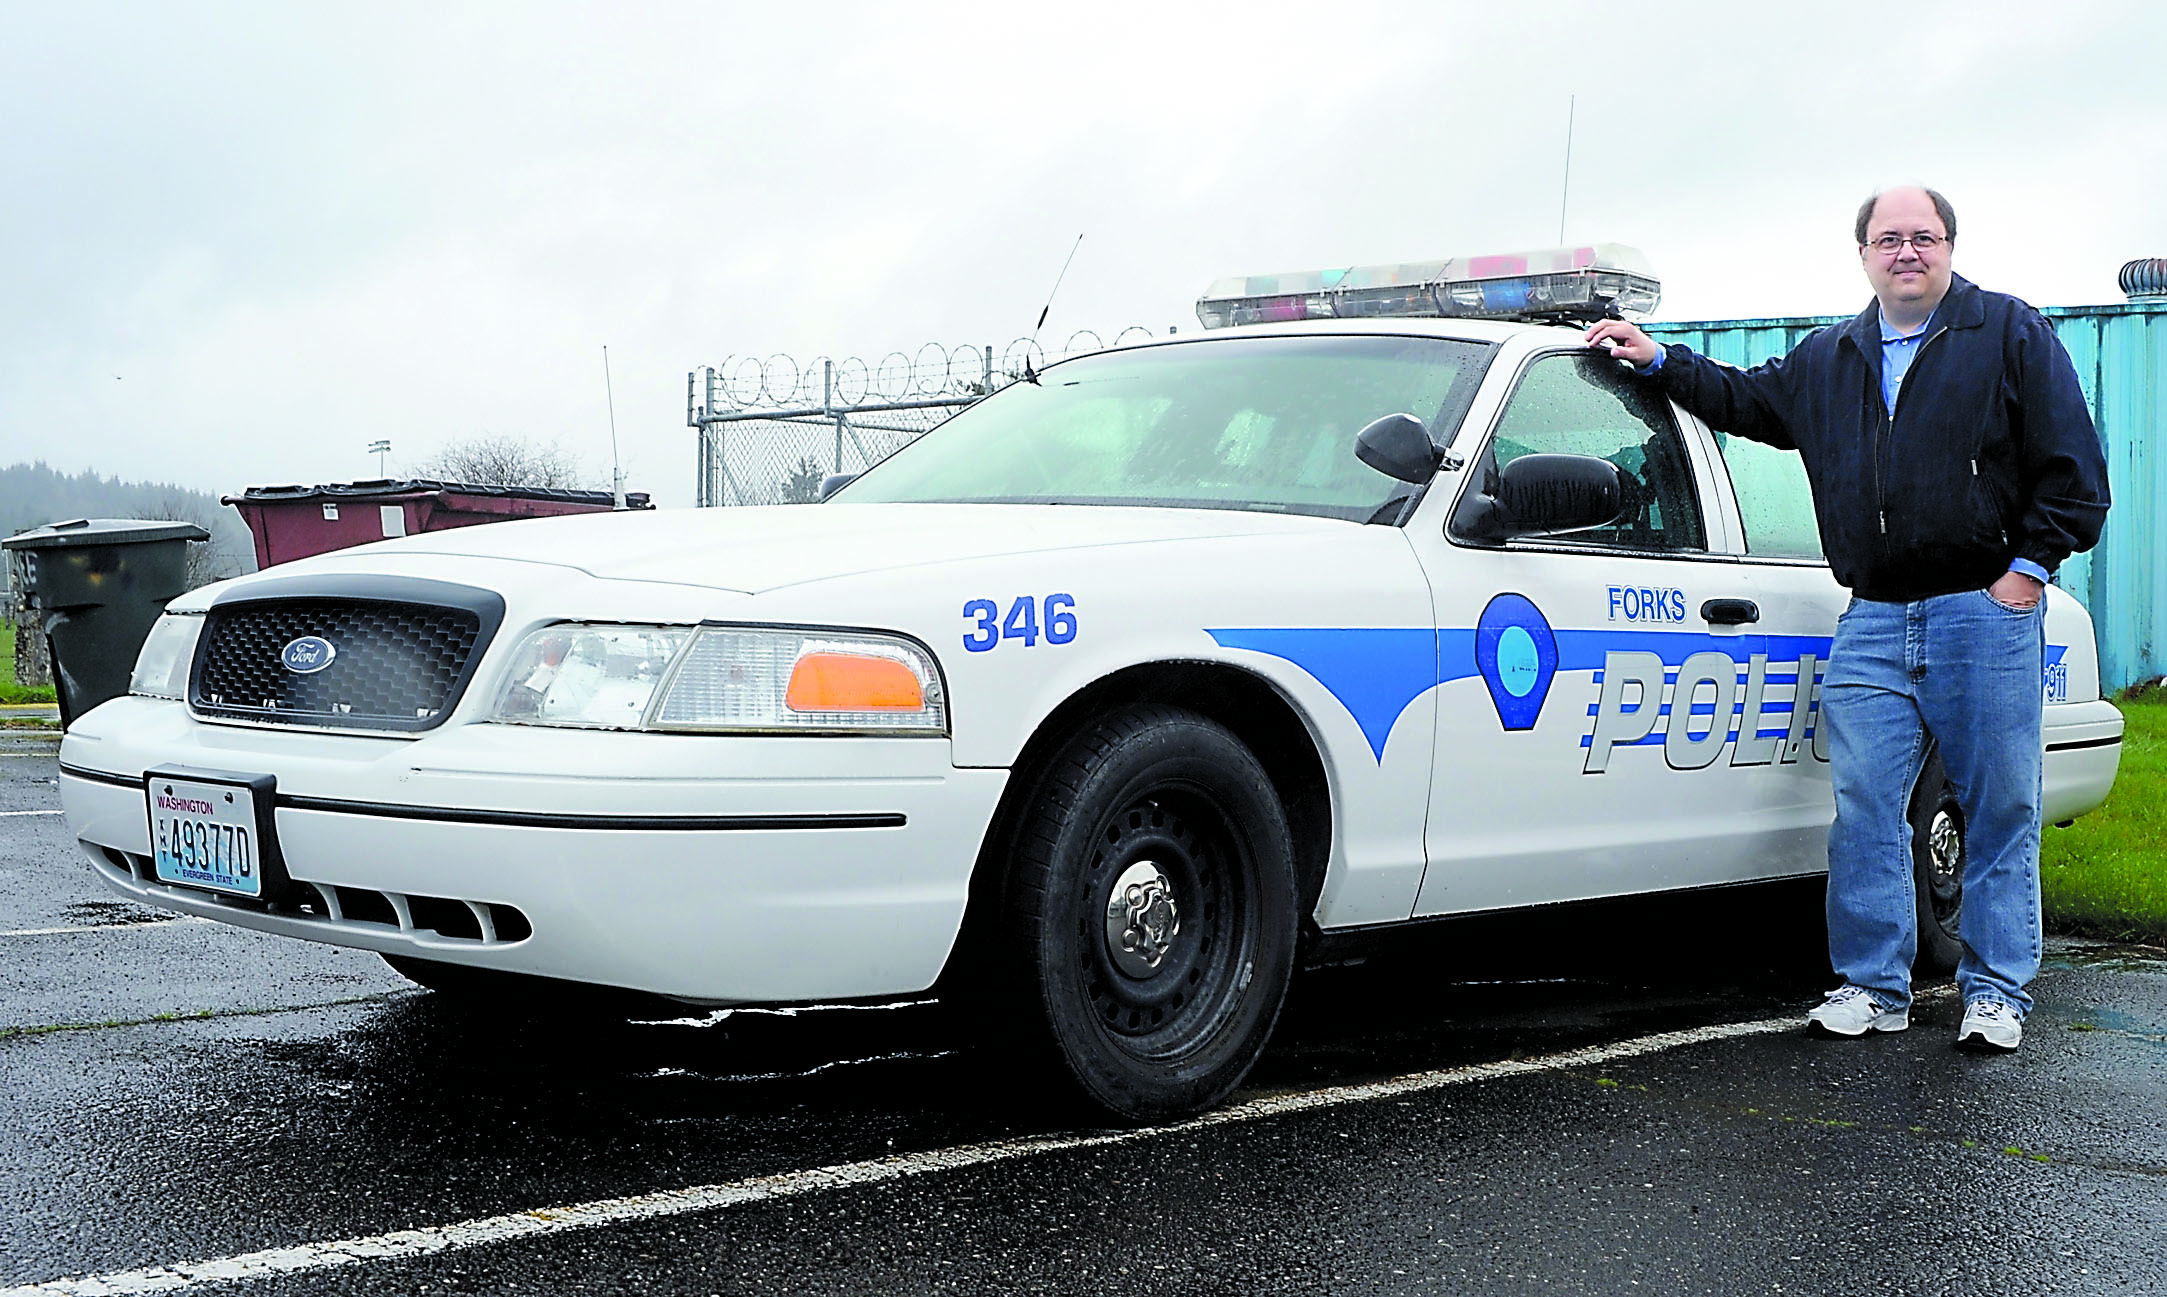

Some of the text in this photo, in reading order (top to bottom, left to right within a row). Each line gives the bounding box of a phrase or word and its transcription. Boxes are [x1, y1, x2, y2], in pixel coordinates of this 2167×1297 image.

[1607, 586, 1686, 623] FORKS
[963, 593, 1078, 652] 346
[291, 642, 320, 663] Ford
[157, 796, 213, 814] WASHINGTON
[171, 818, 250, 877] 49377D
[182, 869, 233, 885] EVERGREEN STATE
